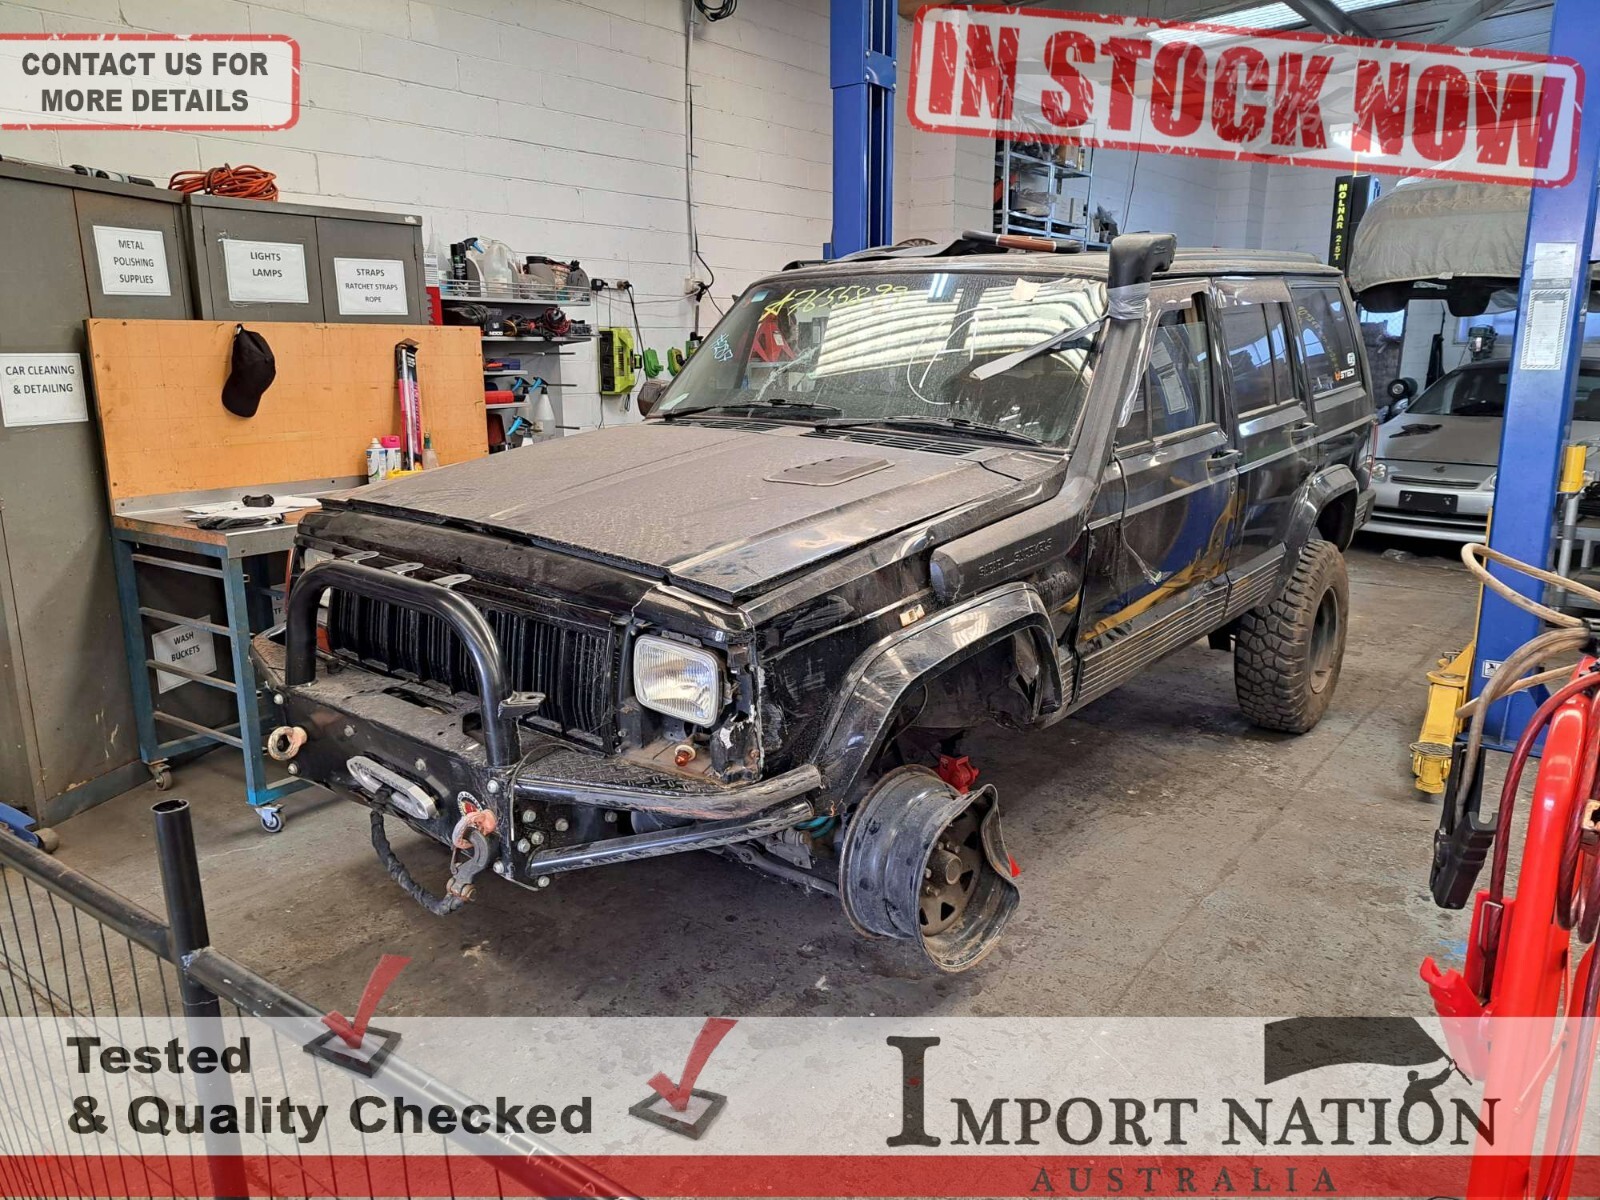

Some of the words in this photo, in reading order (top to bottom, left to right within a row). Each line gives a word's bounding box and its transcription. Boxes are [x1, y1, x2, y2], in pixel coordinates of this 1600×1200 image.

[1336, 184, 1348, 230] MOLNAR
[118, 239, 145, 250] METAL
[113, 256, 155, 268] POLISHING
[250, 252, 281, 262] LIGHTS
[252, 268, 283, 278] LAMPS
[356, 268, 385, 277] STRAPS
[119, 274, 154, 284] SUPPLIES
[345, 282, 374, 291] RATCHET
[375, 283, 398, 292] STRAPS
[365, 295, 382, 303] ROPE
[5, 366, 26, 376] CAR
[27, 365, 75, 375] CLEANING
[13, 385, 21, 394] &
[23, 383, 73, 394] DETAILING
[173, 631, 194, 645] WASH
[171, 645, 200, 662] BUCKETS
